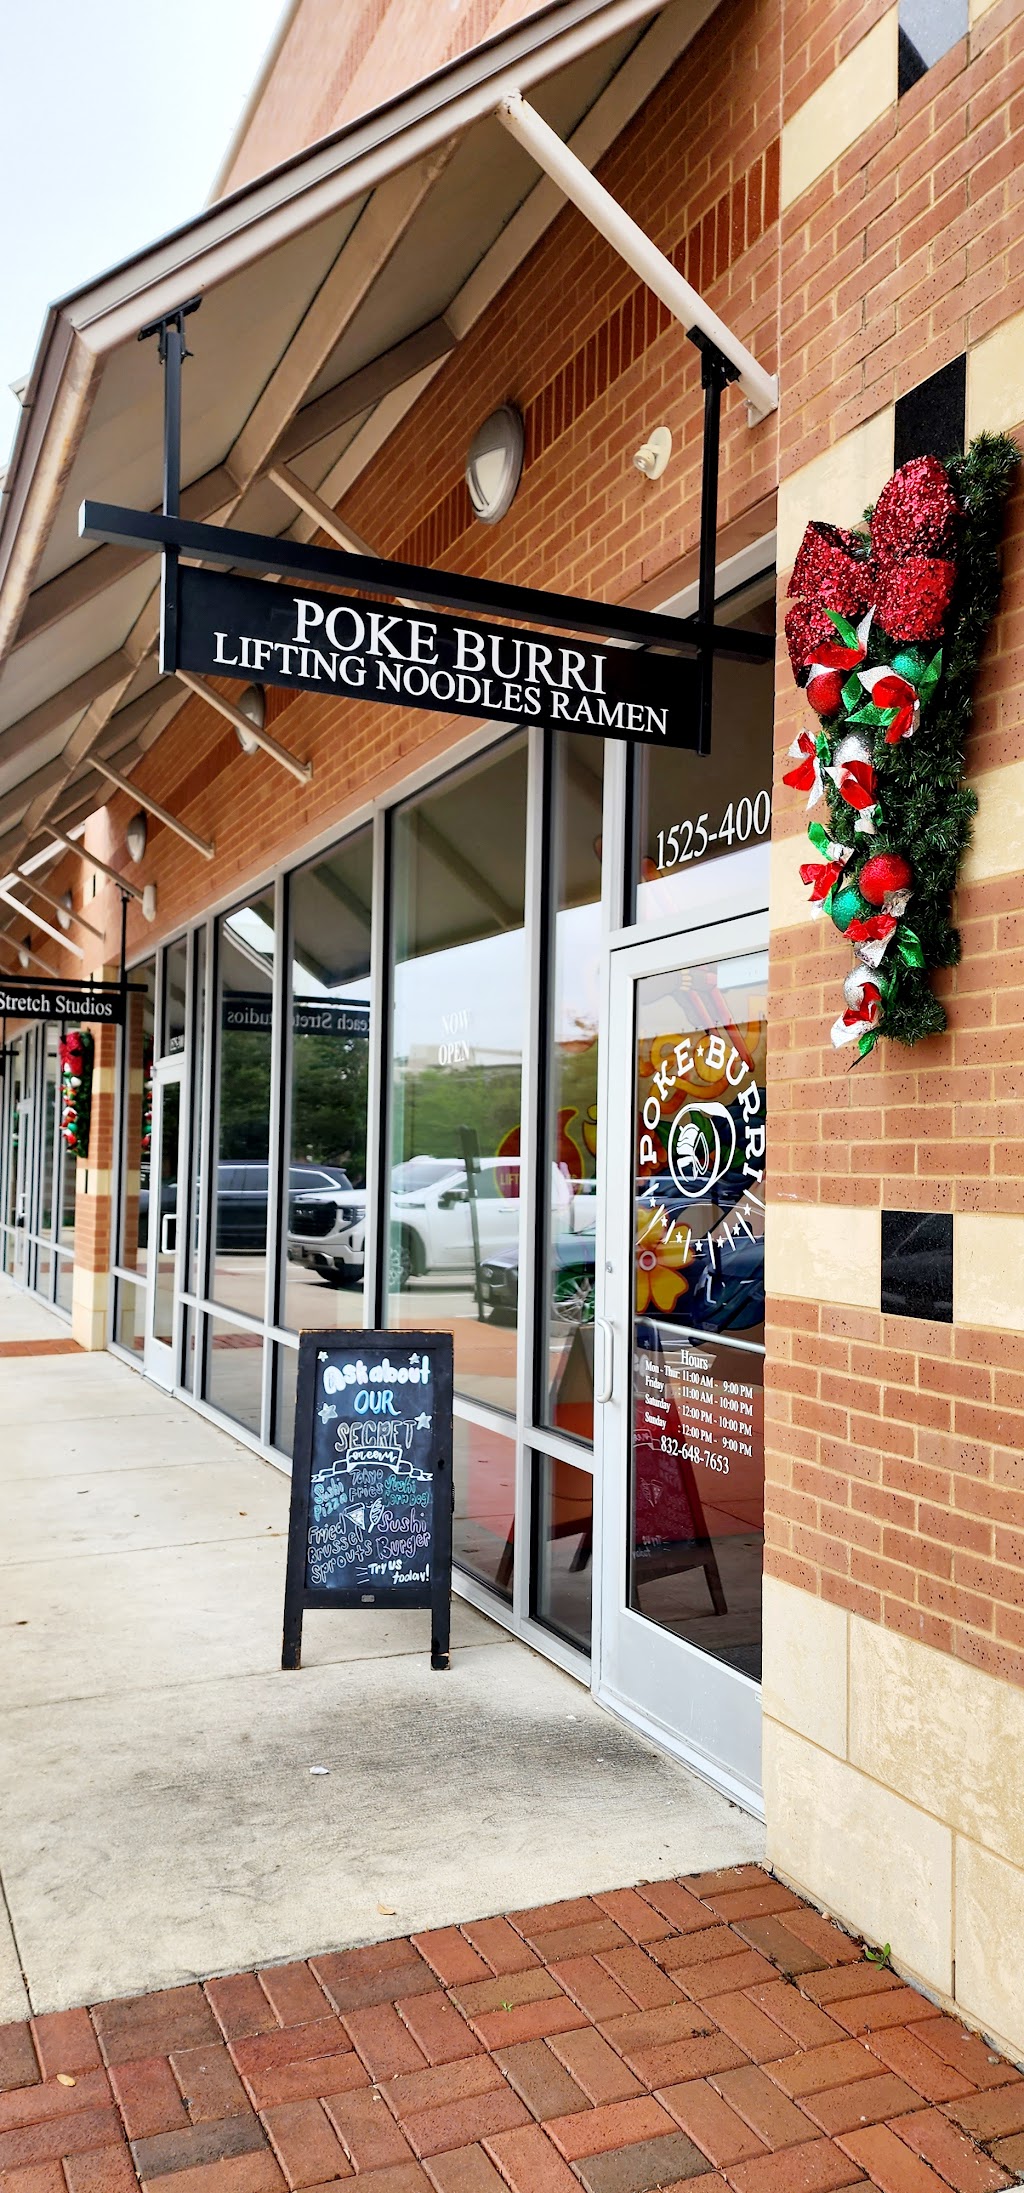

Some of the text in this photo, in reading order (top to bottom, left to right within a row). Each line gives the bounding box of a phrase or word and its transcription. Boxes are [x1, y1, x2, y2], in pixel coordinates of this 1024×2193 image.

[291, 597, 607, 695] POKE BURRI
[212, 631, 669, 735] LIFTING NOODLES RAMEN
[656, 790, 771, 871] 1525-400
[0, 991, 112, 1016] Stretch Studios
[441, 1009, 471, 1037] NOW
[438, 1039, 471, 1066] OPEN
[639, 1034, 765, 1183] POKE BURRI
[369, 1355, 431, 1384] about
[680, 1349, 709, 1370] Hours
[645, 1360, 659, 1374] Mon
[682, 1370, 700, 1385] 11:00
[700, 1374, 714, 1388] AM
[723, 1380, 739, 1395] 9:00
[740, 1385, 753, 1399] PM
[354, 1390, 401, 1416] OUR
[645, 1376, 665, 1393] Friday
[682, 1386, 700, 1401] 11:00
[700, 1391, 714, 1405] AM
[719, 1396, 739, 1412] 10:00
[740, 1402, 753, 1416] PM
[645, 1394, 671, 1413] Saturday
[682, 1405, 700, 1420] 12:00
[701, 1410, 713, 1424] PM
[719, 1416, 738, 1432] 10:00
[739, 1422, 752, 1437] PM
[334, 1420, 417, 1452] SECRET
[645, 1412, 667, 1430] Sunday
[682, 1424, 700, 1439] 12:00
[701, 1430, 713, 1444] PM
[722, 1437, 738, 1453] 9:00
[739, 1442, 752, 1457] PM
[660, 1435, 730, 1475] 832-648-7653
[314, 1478, 344, 1504] Sushi
[349, 1482, 384, 1502] Fries
[384, 1474, 416, 1494] Sushi
[308, 1513, 346, 1544] Fried
[377, 1508, 427, 1533] Sushi
[307, 1525, 363, 1564] Brussel
[376, 1532, 431, 1559] Burger
[368, 1563, 387, 1575] Try
[392, 1563, 430, 1584] today!
